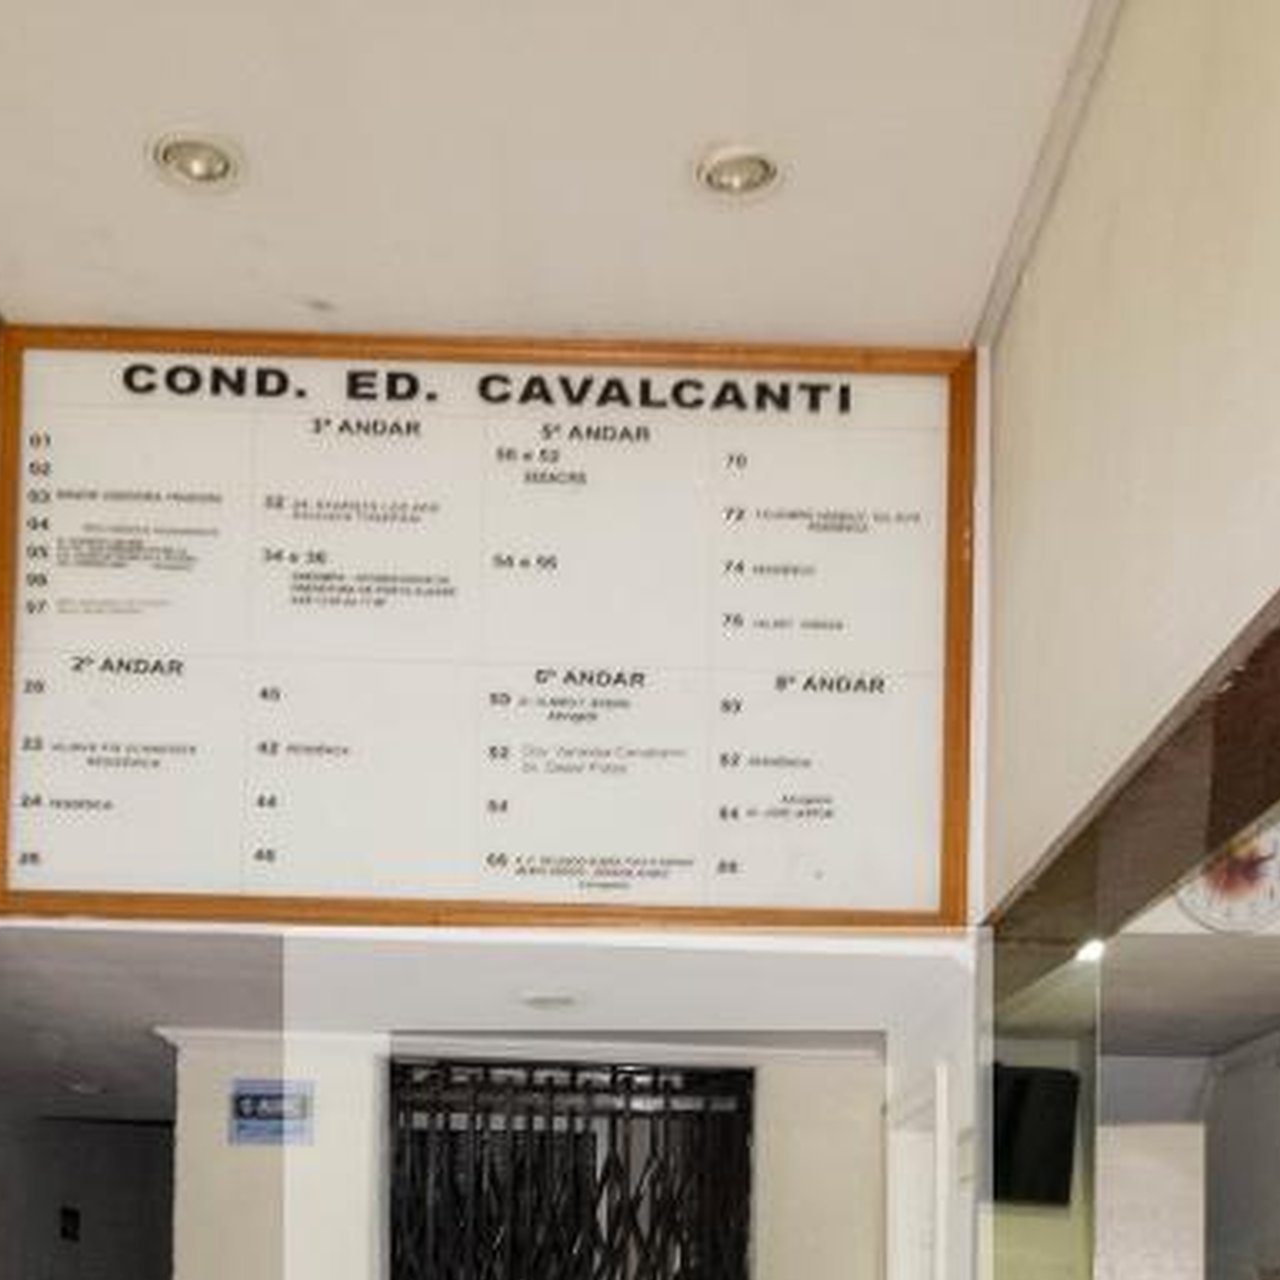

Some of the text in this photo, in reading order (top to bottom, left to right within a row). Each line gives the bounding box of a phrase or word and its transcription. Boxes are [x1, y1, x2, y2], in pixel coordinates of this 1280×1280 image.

[122, 363, 853, 414] COND. ED. CAVALCANTI
[338, 419, 421, 436] ANDAR
[568, 425, 650, 442] ANDAR
[99, 657, 184, 675] ANDAR
[562, 669, 645, 688] ANDAR
[802, 676, 885, 694] ANDAR
